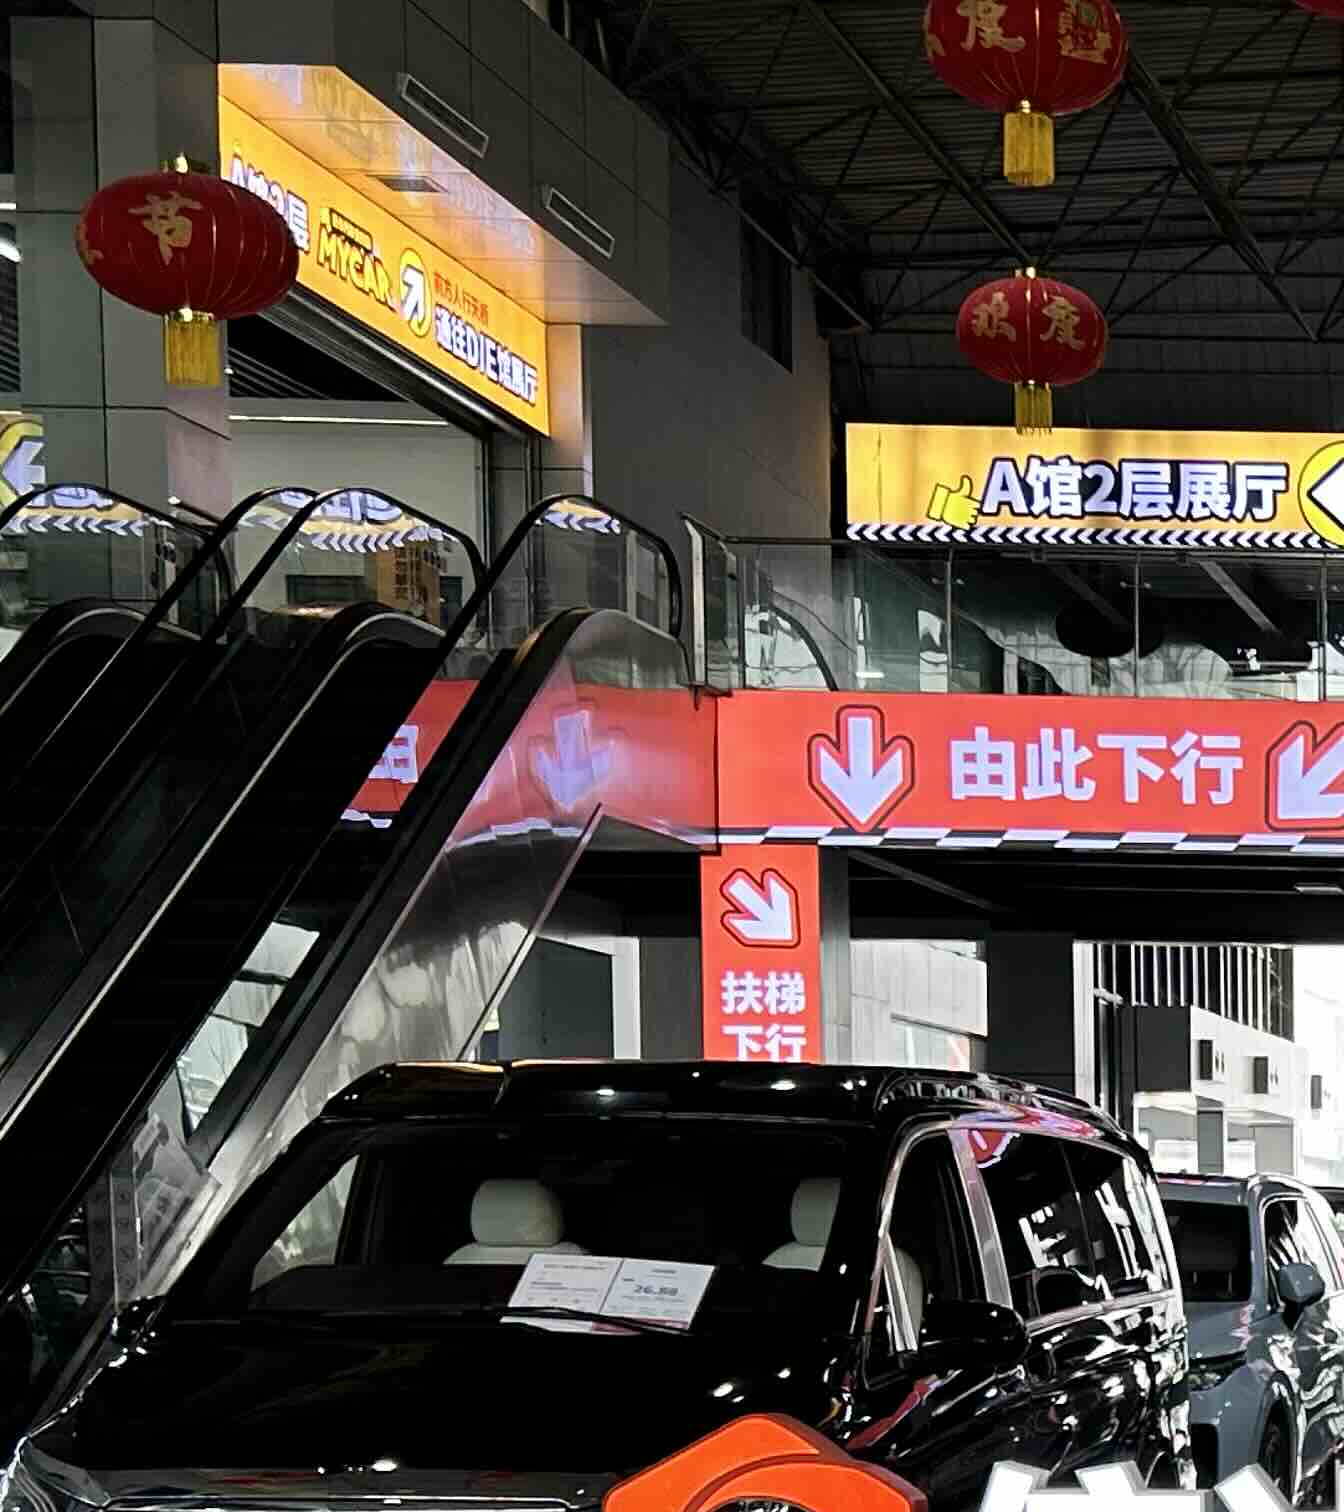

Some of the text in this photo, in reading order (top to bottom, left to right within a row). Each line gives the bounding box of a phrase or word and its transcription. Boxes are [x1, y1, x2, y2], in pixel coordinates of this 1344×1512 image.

[981, 456, 1290, 522] A馆2层展厅
[949, 726, 1244, 806] 由此下行
[720, 969, 807, 1015] 扶梯
[722, 1024, 807, 1062] 下行
